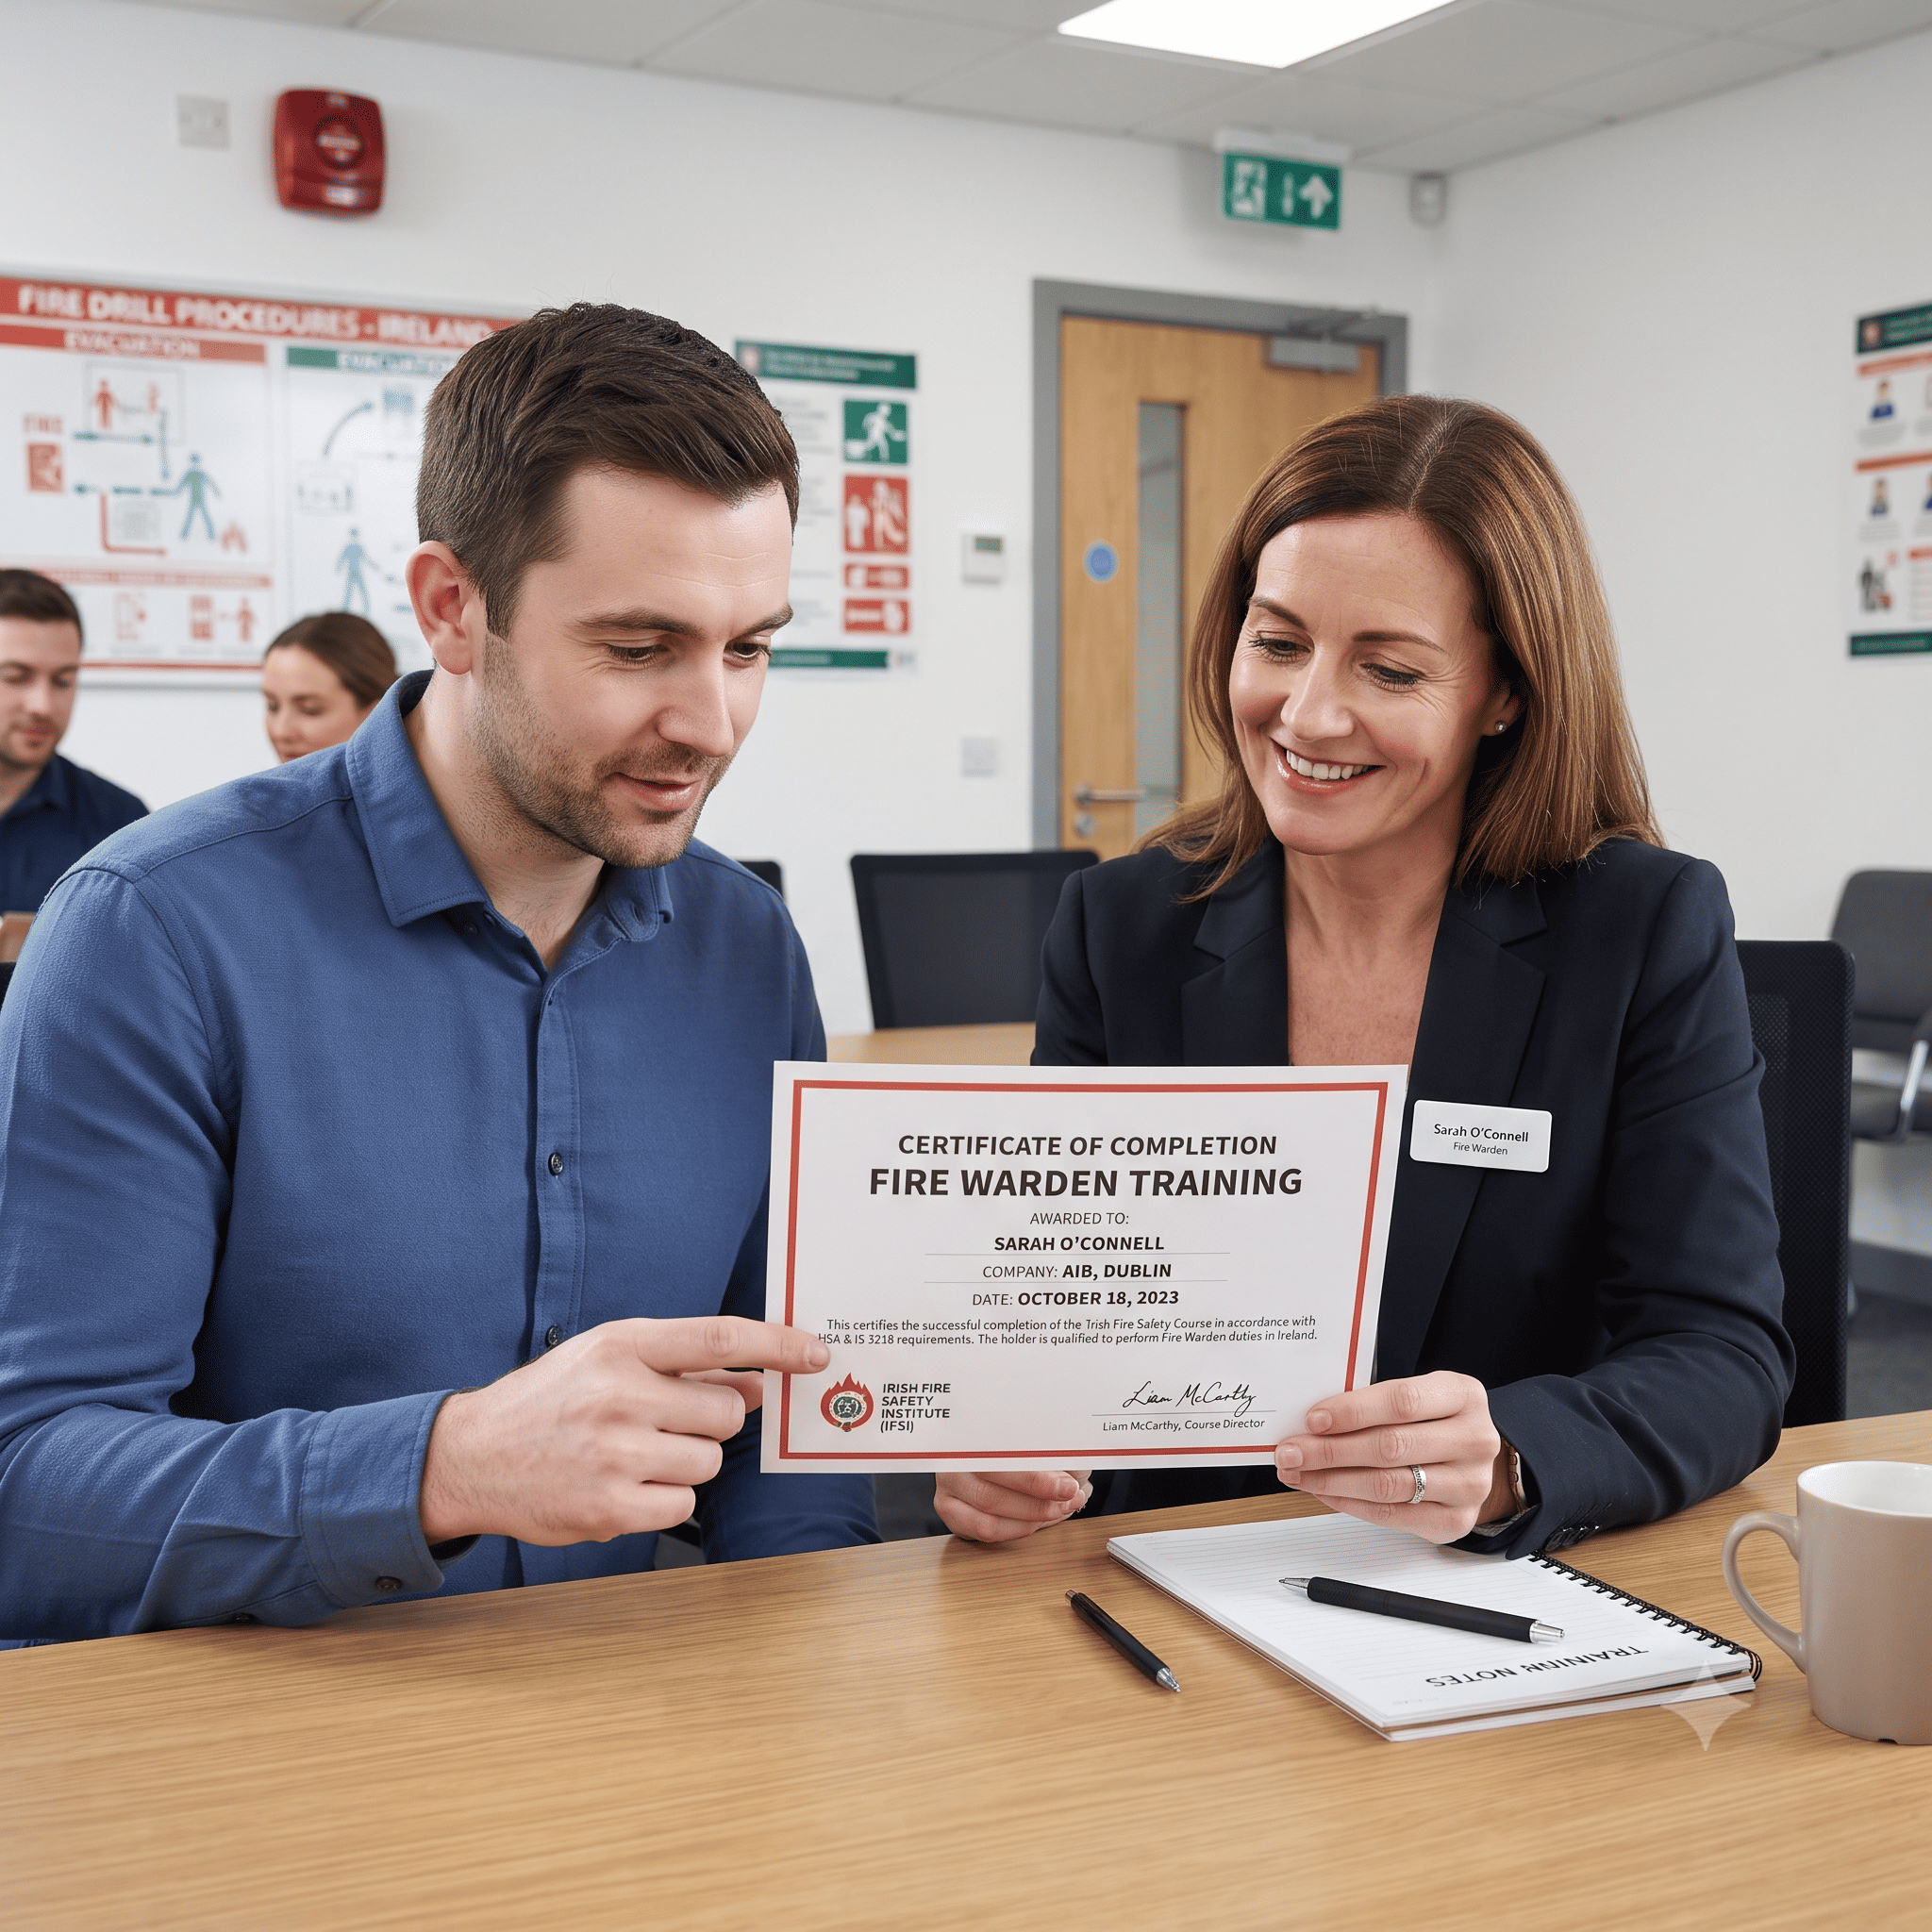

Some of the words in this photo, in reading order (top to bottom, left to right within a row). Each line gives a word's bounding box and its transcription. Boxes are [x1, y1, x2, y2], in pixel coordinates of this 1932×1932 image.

[18, 285, 85, 317] FIRE
[88, 290, 172, 325] DRILL
[175, 297, 359, 340] PROCEDURES
[1433, 1123, 1467, 1138] Sarah
[898, 1134, 1062, 1156] CERTIFICATE
[1069, 1136, 1104, 1157] OF
[1109, 1135, 1277, 1157] COMPLETION
[1453, 1141, 1470, 1152] Fire
[1472, 1142, 1508, 1156] Warden
[870, 1168, 950, 1196] FIRE
[960, 1169, 1118, 1197] WARDEN
[1128, 1168, 1302, 1197] TRAINING
[1029, 1212, 1103, 1225] AWARDED
[1106, 1211, 1129, 1225] TO:
[993, 1236, 1056, 1251] SARAH
[982, 1265, 1058, 1278] COMPANY:
[1061, 1264, 1099, 1280] AIB,
[1103, 1263, 1172, 1278] DUBLIN
[972, 1293, 1012, 1307] DATE:
[1017, 1291, 1102, 1307] OCTOBER
[1106, 1291, 1133, 1308] 18,
[1136, 1290, 1179, 1305] 2023
[826, 1319, 850, 1330] This
[853, 1319, 899, 1331] certifies
[901, 1319, 920, 1331] the
[922, 1319, 981, 1331] successful
[983, 1319, 1047, 1333] completion
[1049, 1319, 1061, 1330] of
[1063, 1319, 1082, 1330] the
[1113, 1318, 1135, 1329] Fire
[1137, 1318, 1172, 1332] Safety
[1174, 1318, 1212, 1329] Course
[1214, 1317, 1225, 1328] in
[1227, 1316, 1290, 1328] accordance
[1291, 1315, 1316, 1326] with
[818, 1333, 841, 1344] HSA
[843, 1334, 853, 1344] &
[855, 1334, 865, 1344] IS
[868, 1334, 894, 1344] 3218
[897, 1333, 974, 1347] requirements.
[977, 1333, 998, 1344] The
[1001, 1333, 1037, 1344] holder
[1039, 1333, 1048, 1344] is
[1050, 1332, 1099, 1346] qualified
[1102, 1333, 1113, 1344] to
[1115, 1332, 1159, 1345] perform
[1161, 1332, 1182, 1342] Fire
[1185, 1331, 1226, 1342] Warden
[1228, 1330, 1262, 1341] duties
[1265, 1330, 1274, 1341] in
[1277, 1328, 1318, 1341] Ireland.
[882, 1383, 919, 1393] IRISH
[922, 1383, 952, 1393] FIRE
[881, 1395, 934, 1407] SAFETY
[1123, 1380, 1173, 1408] Liam
[1174, 1381, 1257, 1418] McCarthy
[881, 1407, 951, 1419] INSTITUTE
[880, 1420, 914, 1434] (IFSI)
[1103, 1422, 1128, 1431] Liam
[1130, 1420, 1181, 1432] McCarthy,
[1184, 1420, 1222, 1430] Course
[1223, 1419, 1265, 1428] Director
[1424, 1667, 1518, 1688] NOTES
